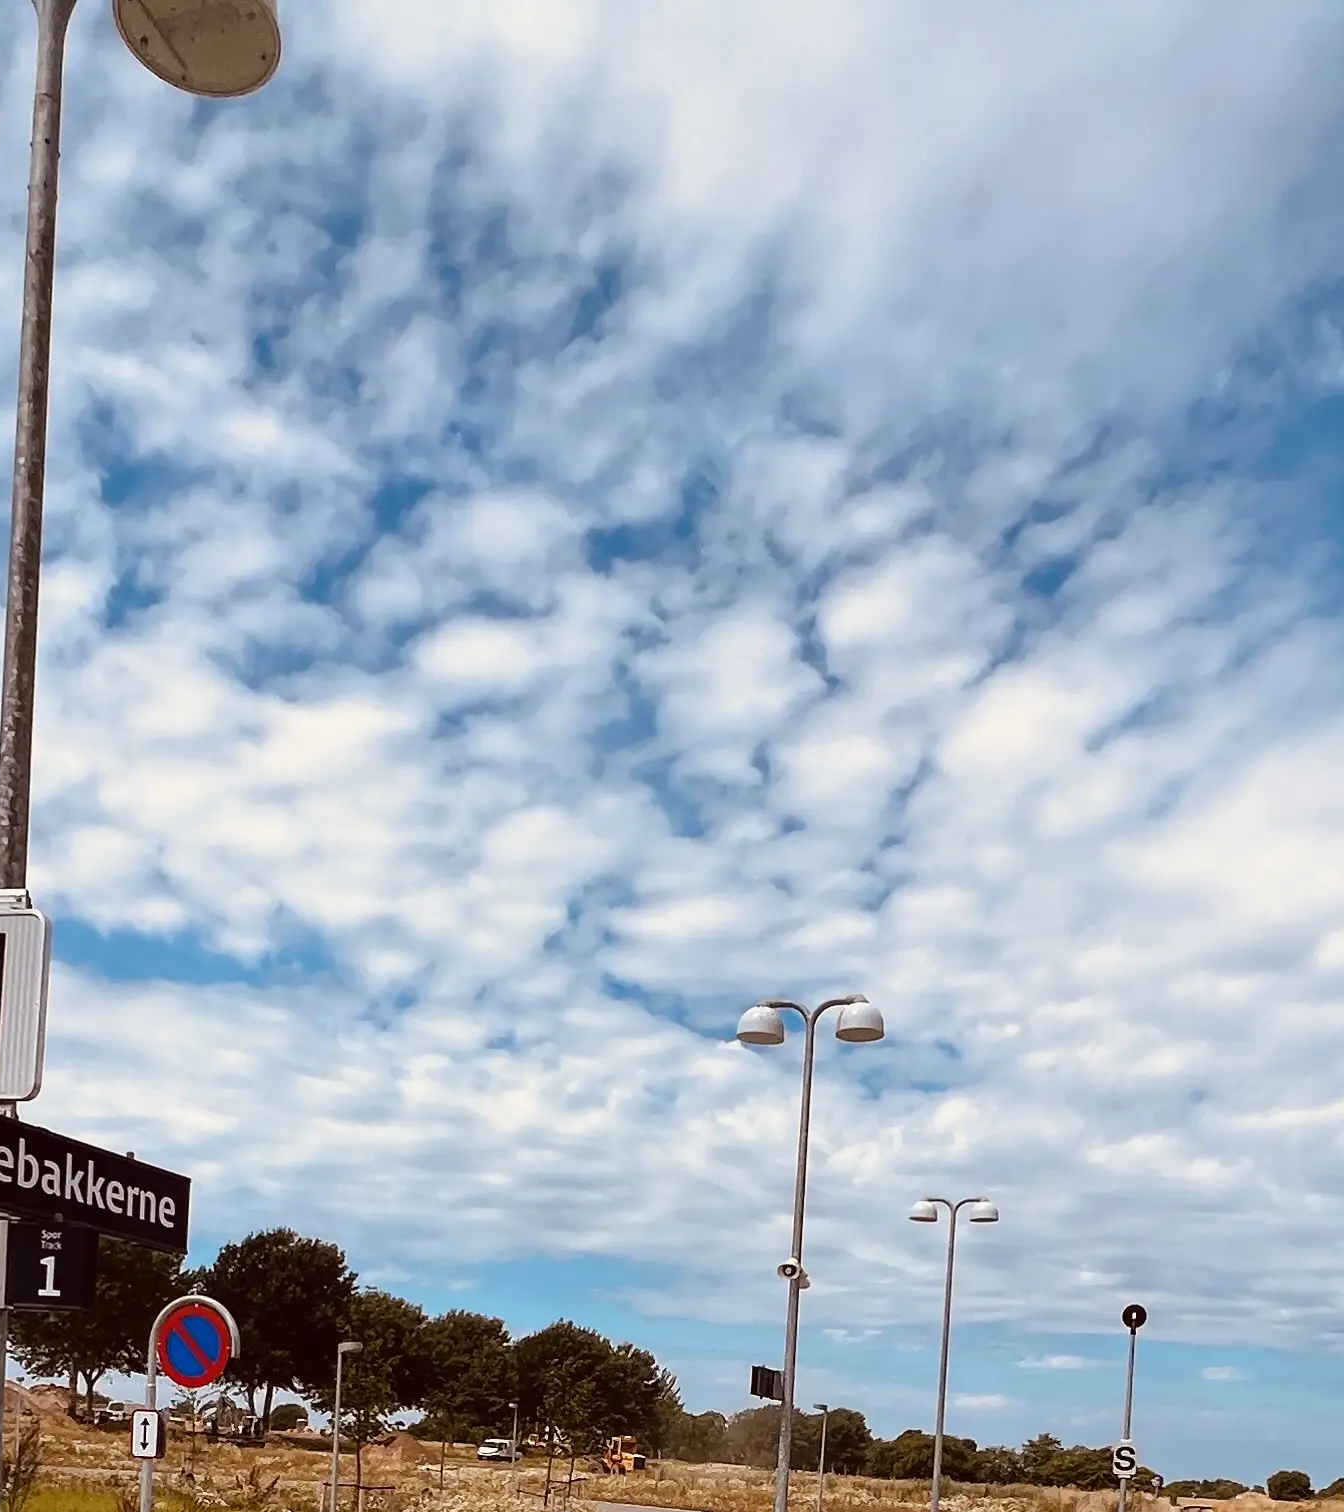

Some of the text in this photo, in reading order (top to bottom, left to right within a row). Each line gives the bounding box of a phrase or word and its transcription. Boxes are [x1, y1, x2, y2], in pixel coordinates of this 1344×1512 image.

[41, 1229, 62, 1240] Spor
[40, 1240, 63, 1250] Track
[38, 1255, 61, 1297] 1
[1114, 1446, 1136, 1471] S
